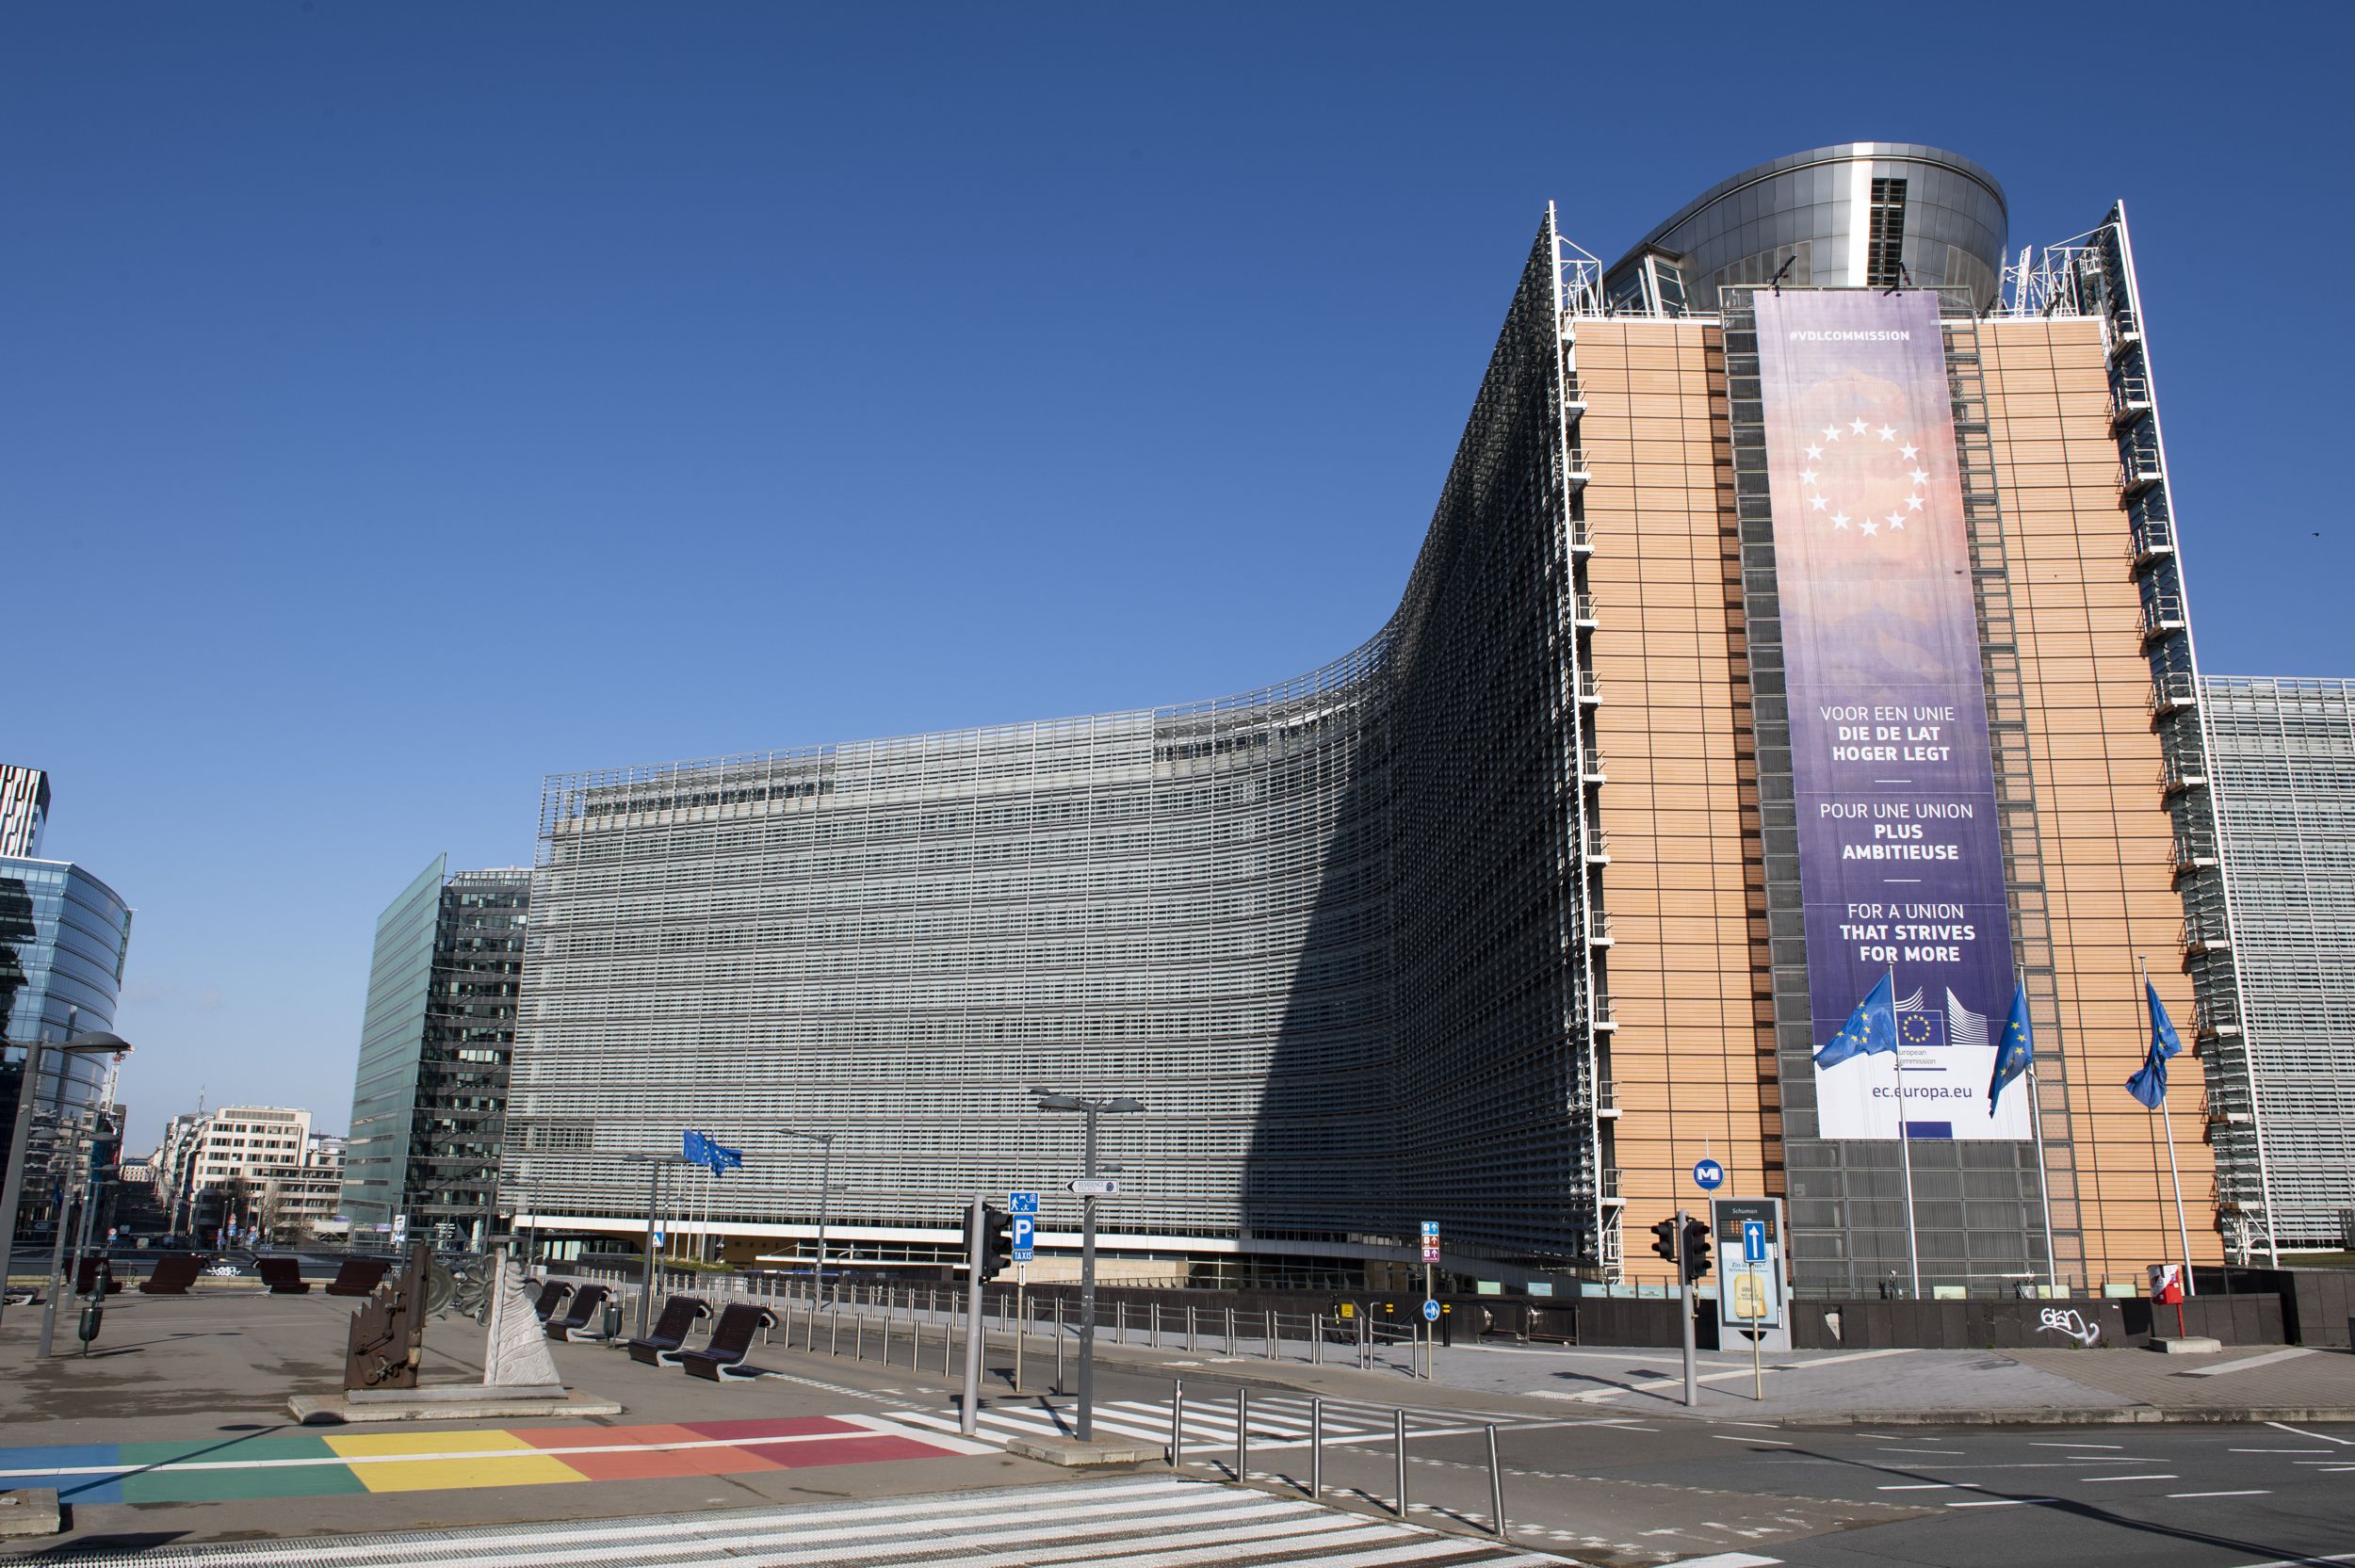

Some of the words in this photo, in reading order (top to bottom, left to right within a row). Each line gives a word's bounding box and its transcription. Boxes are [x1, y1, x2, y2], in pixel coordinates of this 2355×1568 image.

[1790, 331, 1909, 341] #VDLCOMMISSION
[1820, 706, 1869, 721] VOOR
[1875, 706, 1908, 721] EEN
[1913, 706, 1955, 721] UNIE
[1838, 726, 1870, 741] DIE
[1876, 726, 1901, 741] DE
[1907, 726, 1941, 741] LAT
[1832, 746, 1897, 761] HOGER
[1904, 746, 1950, 761] LEGT
[1820, 803, 1868, 818] POUR
[1874, 803, 1909, 818] UNE
[1915, 803, 1973, 818] UNION
[1874, 824, 1923, 839] PLUS
[1843, 845, 1958, 860] AMBITIEUSE
[1848, 903, 1882, 919] FOR
[1888, 903, 1901, 919] A
[1906, 903, 1964, 919] UNION
[1840, 925, 1888, 940] THAT
[1895, 925, 1975, 940] STRIVES
[1860, 946, 1898, 961] FOR
[1905, 946, 1960, 962] MORE
[1873, 1087, 1972, 1100] ec.europa.eu
[1697, 1168, 1719, 1181] M
[1015, 1220, 1031, 1244] P
[1015, 1252, 1032, 1260] TAXIS
